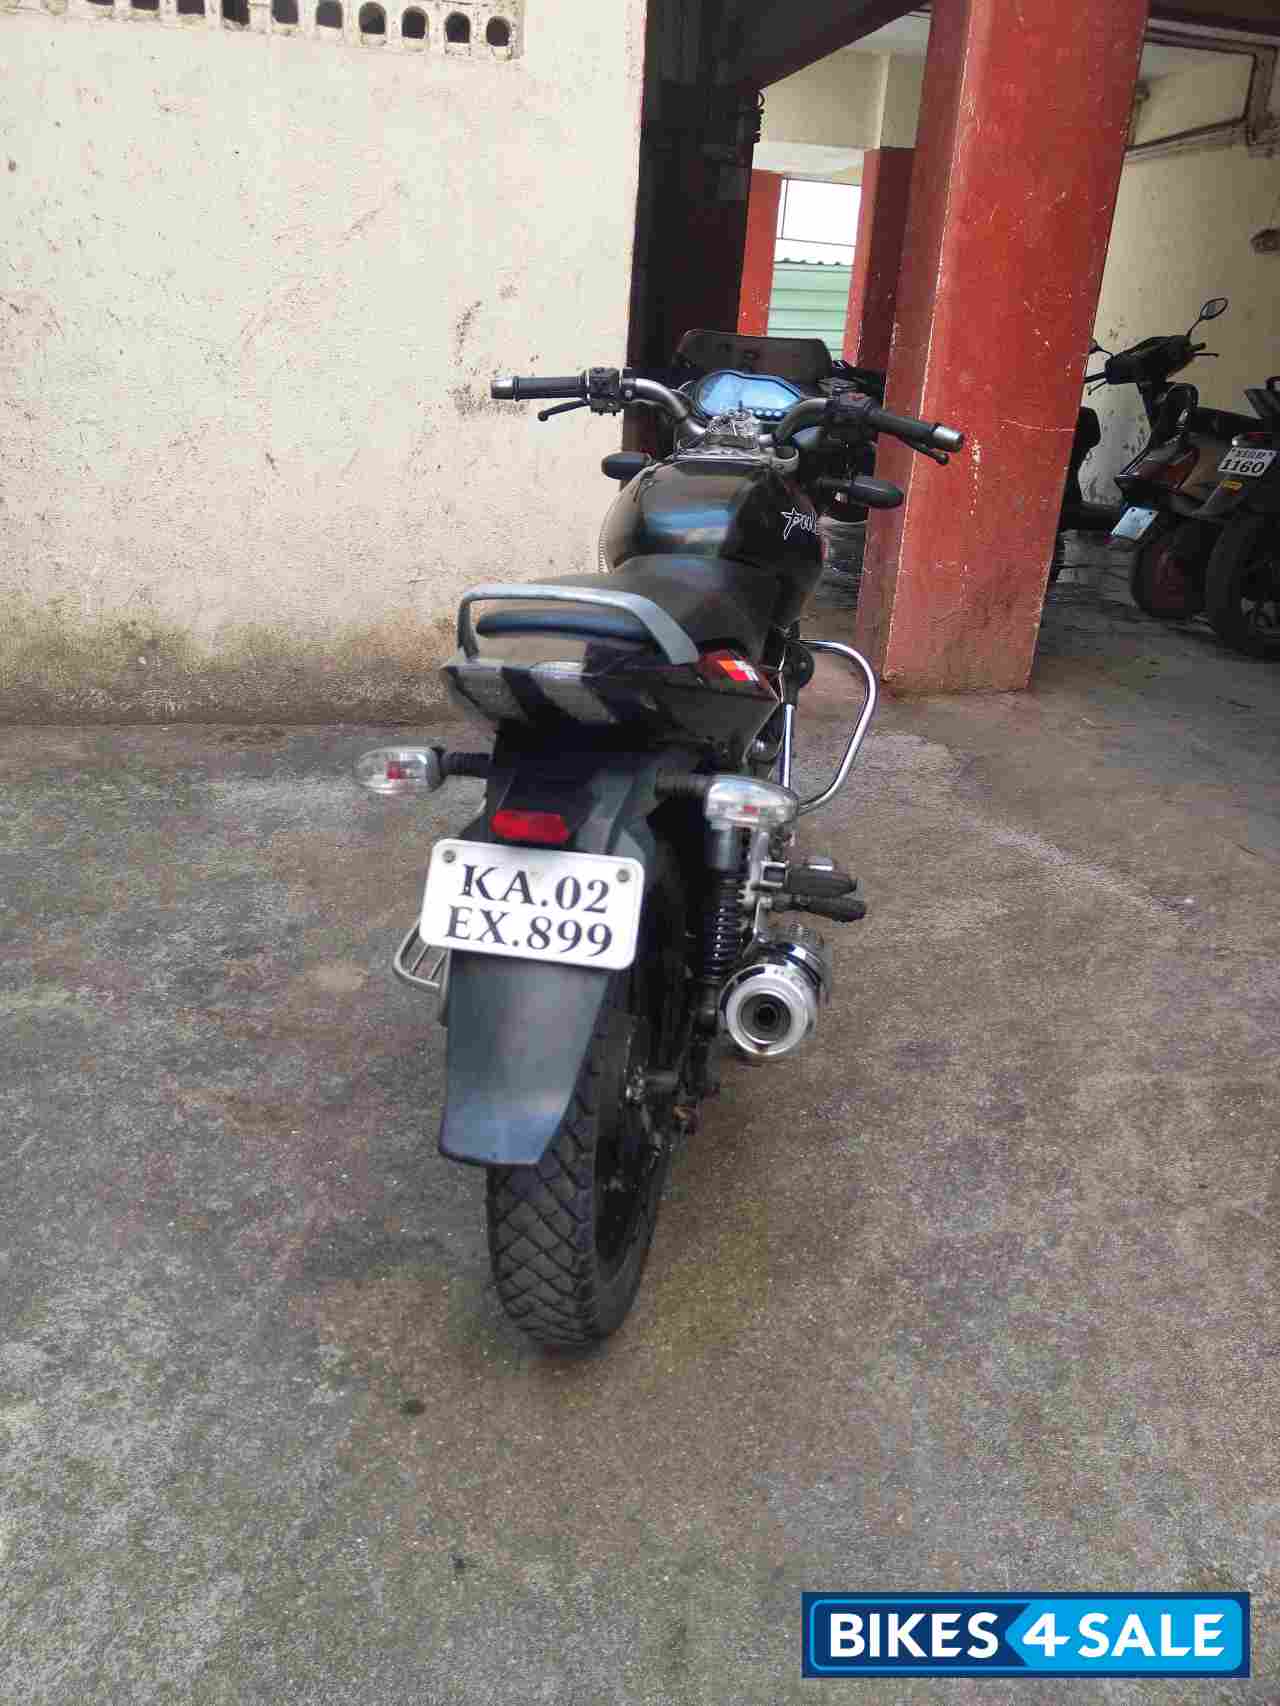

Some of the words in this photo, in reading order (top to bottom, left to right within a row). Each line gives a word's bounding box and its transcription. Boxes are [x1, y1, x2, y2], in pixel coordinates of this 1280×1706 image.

[1221, 459, 1265, 473] 1160
[459, 864, 609, 913] KA.02
[445, 904, 612, 957] EX.899
